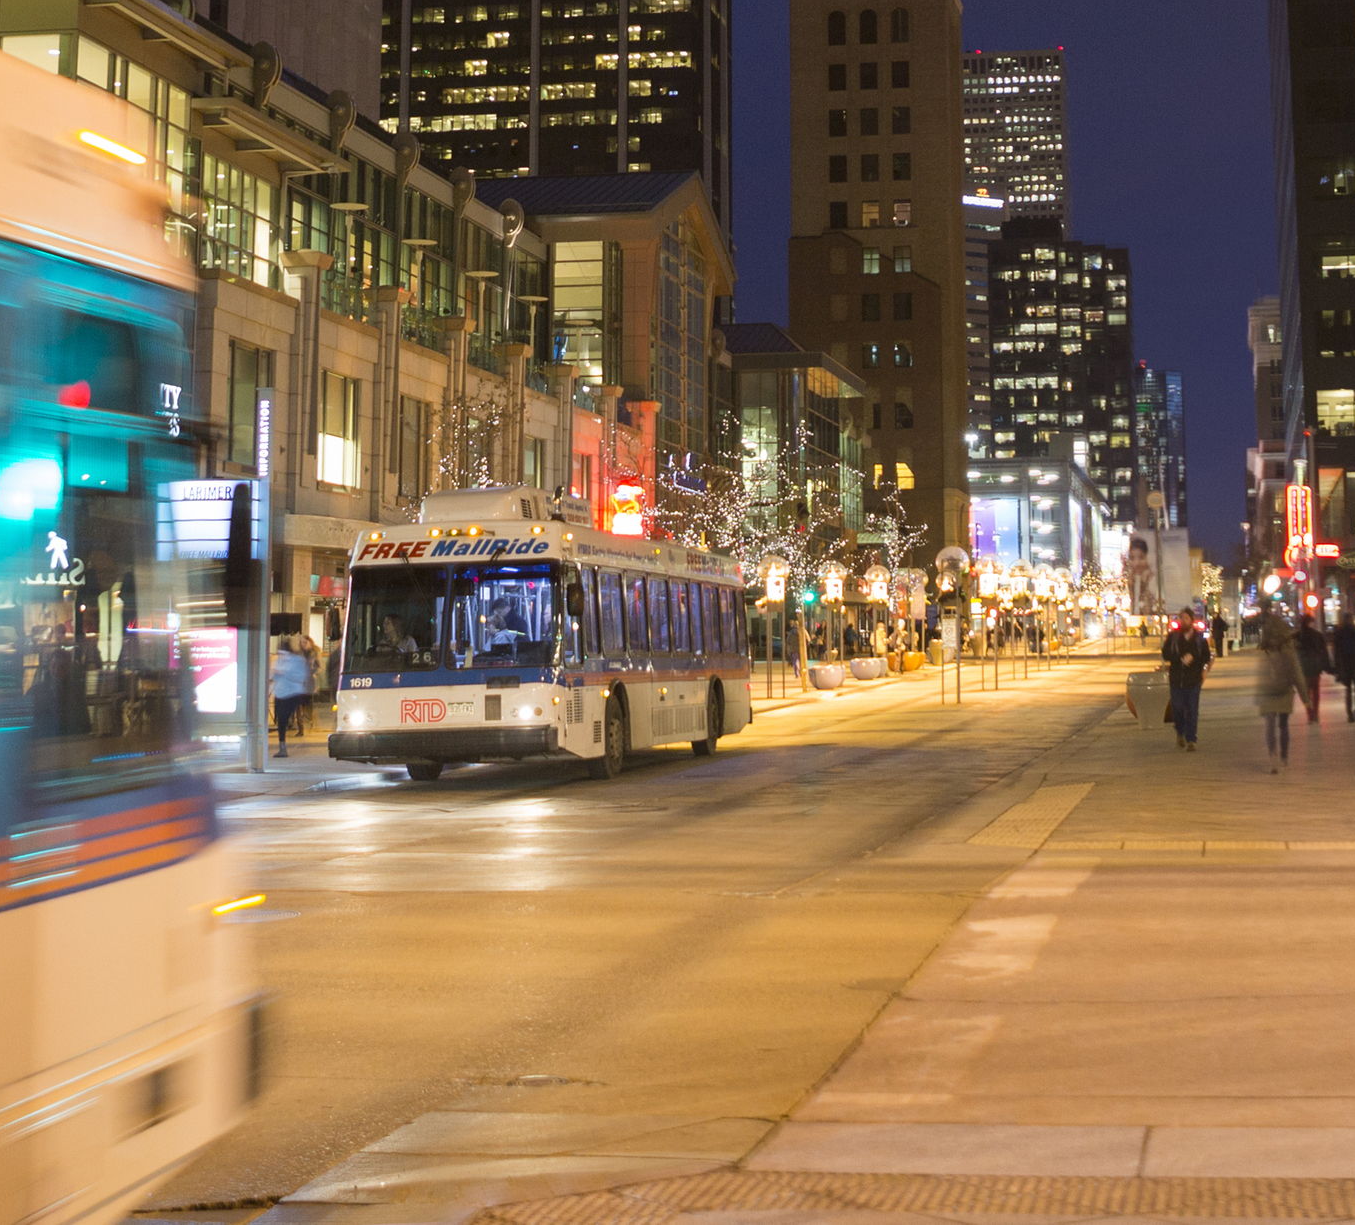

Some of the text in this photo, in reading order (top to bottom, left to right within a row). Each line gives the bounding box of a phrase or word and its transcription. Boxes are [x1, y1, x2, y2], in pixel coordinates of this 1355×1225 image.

[258, 399, 270, 477] INFORMATION
[183, 485, 232, 501] LARIMER
[357, 537, 550, 562] FREE MallRide
[349, 677, 373, 688] 1619
[400, 698, 447, 724] RTD
